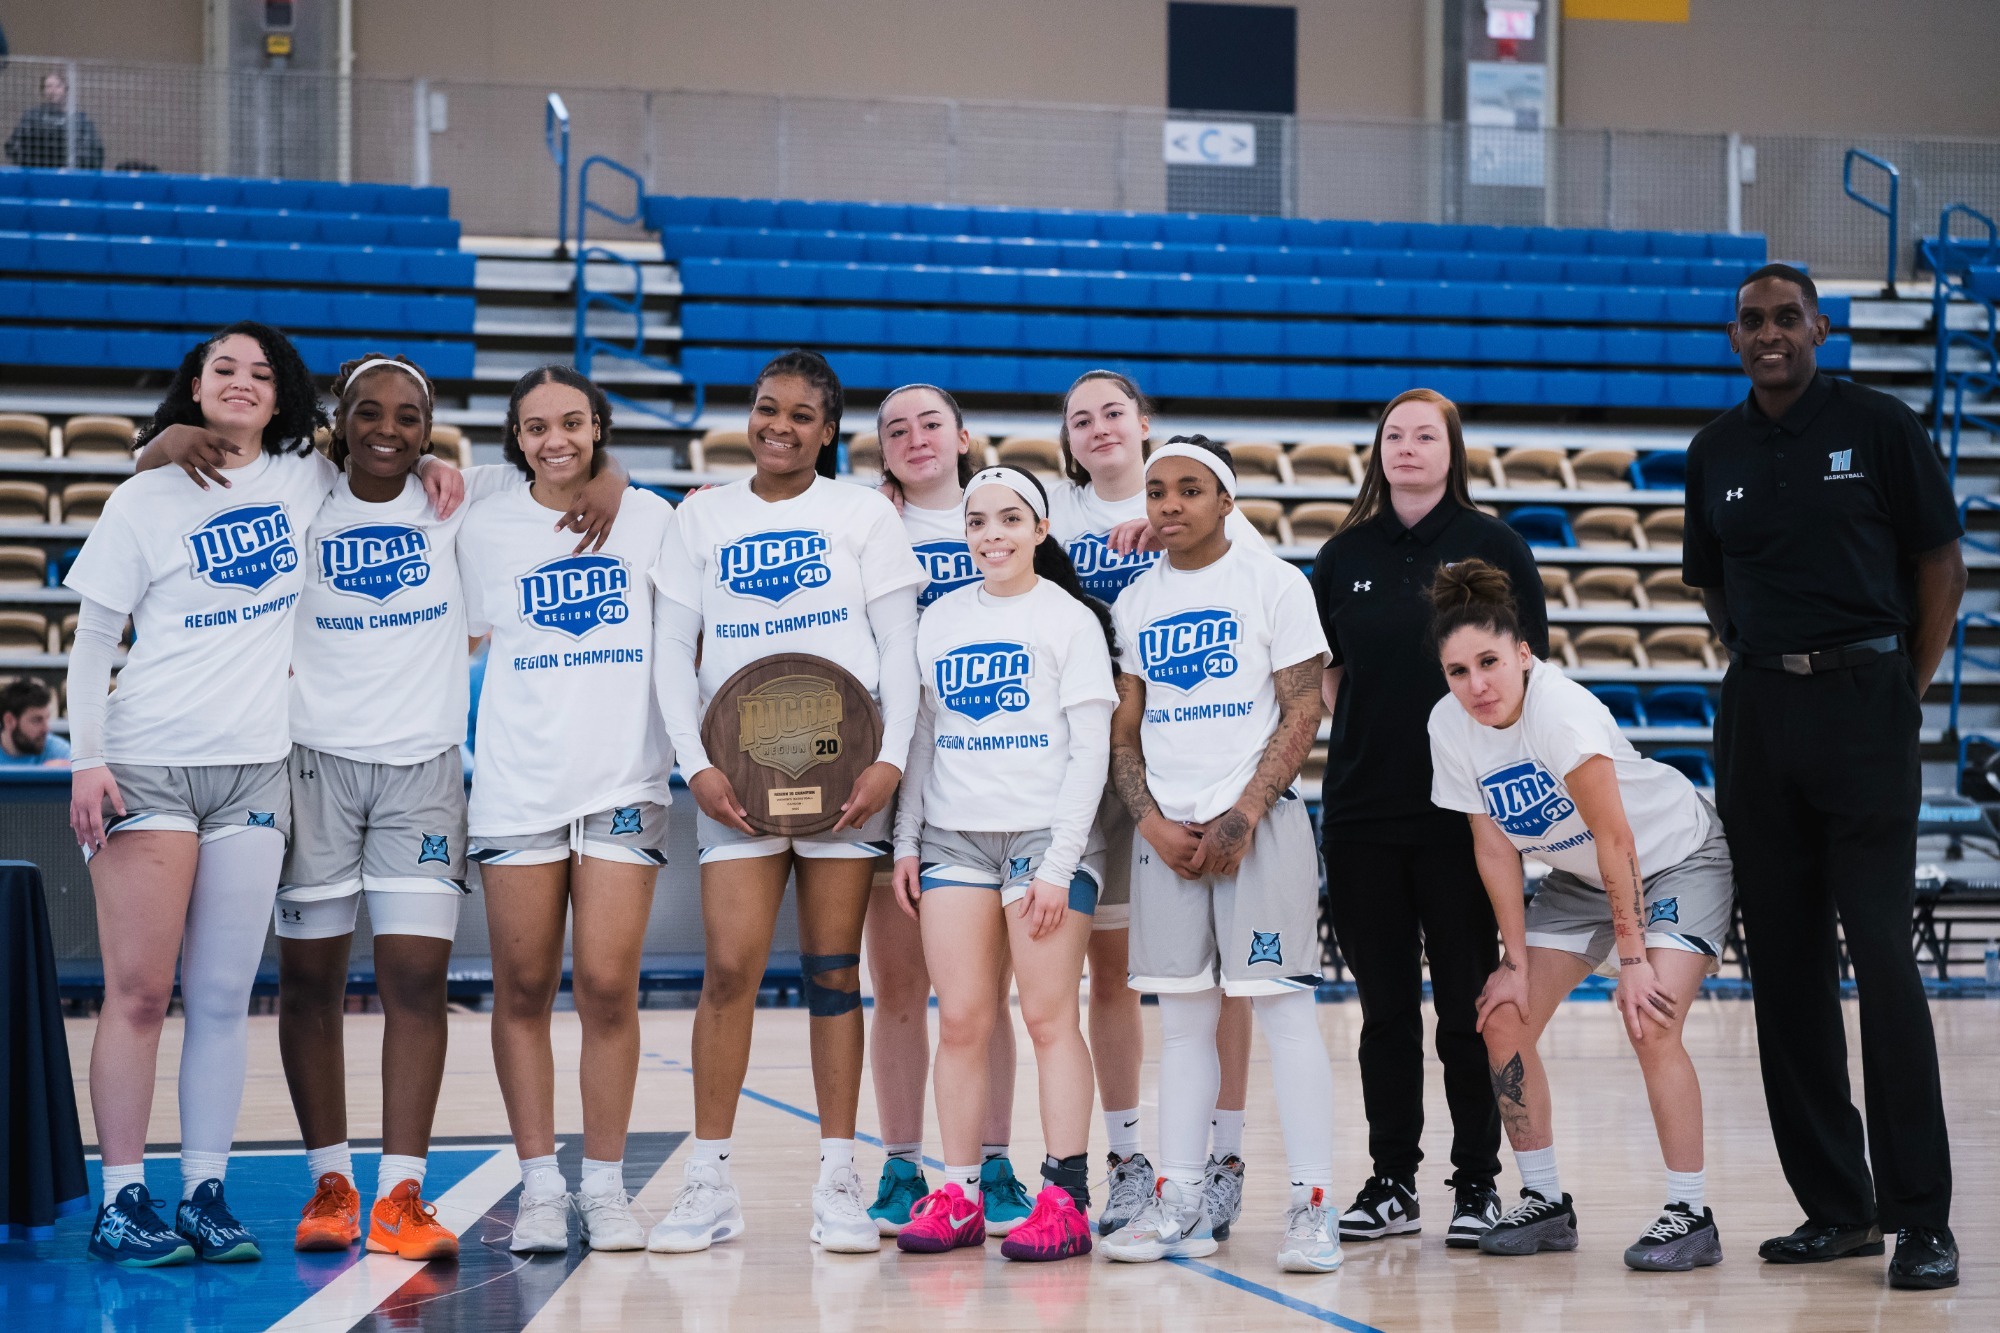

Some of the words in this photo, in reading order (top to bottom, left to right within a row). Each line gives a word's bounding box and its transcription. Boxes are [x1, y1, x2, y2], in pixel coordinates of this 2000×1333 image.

[1824, 472, 1864, 481] BASKETBALL
[190, 513, 290, 574] NJCAA
[321, 531, 426, 578] NJCAA
[221, 561, 267, 579] REGION
[276, 550, 296, 570] 20
[720, 537, 826, 582] NJCAA
[344, 574, 392, 587] REGION
[402, 564, 427, 583] 20
[740, 575, 789, 590] REGION
[800, 567, 828, 584] 20
[521, 568, 627, 616] NJCAA
[185, 609, 237, 628] REGION
[316, 616, 364, 630] REGION
[369, 601, 448, 629] CHAMPIONS
[544, 610, 591, 623] REGION
[602, 604, 626, 620] 20
[716, 622, 760, 638] REGION
[765, 607, 848, 635] CHAMPIONS
[1139, 620, 1238, 670] NJCAA
[514, 653, 559, 671] REGION
[564, 648, 643, 667] CHAMPIONS
[1155, 664, 1198, 678] REGION
[1208, 657, 1234, 674] 20
[935, 653, 1029, 699] NJCAA
[951, 695, 990, 706] REGION
[1001, 692, 1026, 707] 20
[743, 693, 839, 747] NJCAA
[1174, 701, 1254, 722] CHAMPIONS
[764, 744, 806, 756] REGION
[815, 739, 838, 756] 20
[936, 735, 964, 750] REGION
[968, 734, 1049, 751] CHAMPIONS
[1546, 800, 1572, 820] 20
